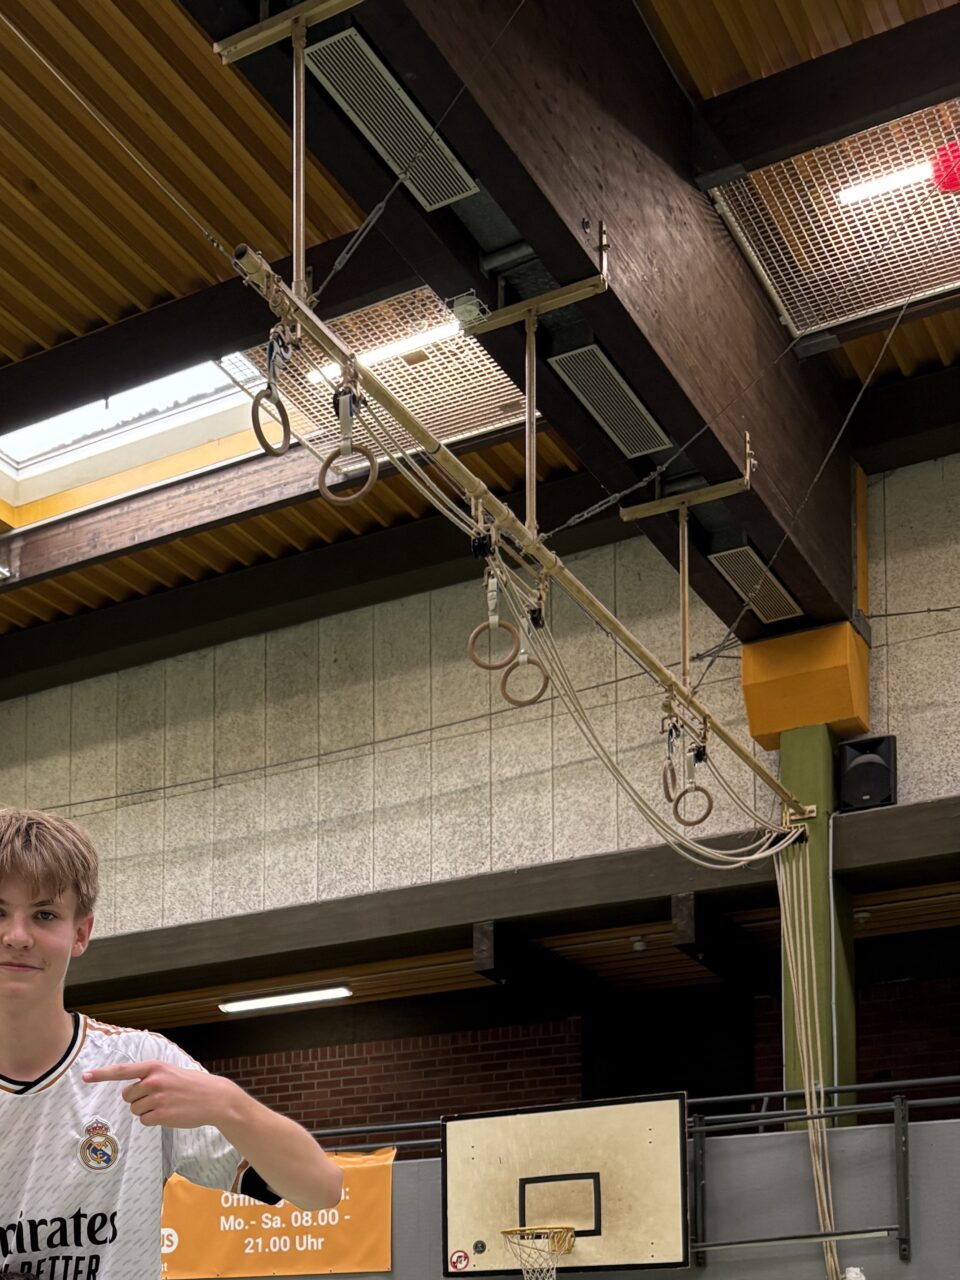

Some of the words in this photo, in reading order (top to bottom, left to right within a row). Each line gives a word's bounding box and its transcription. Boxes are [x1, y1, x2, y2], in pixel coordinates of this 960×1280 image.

[261, 1213, 286, 1229] Sa.
[291, 1208, 339, 1227] 08.00
[244, 1236, 290, 1254] 21.00
[295, 1234, 325, 1251] Uhr
